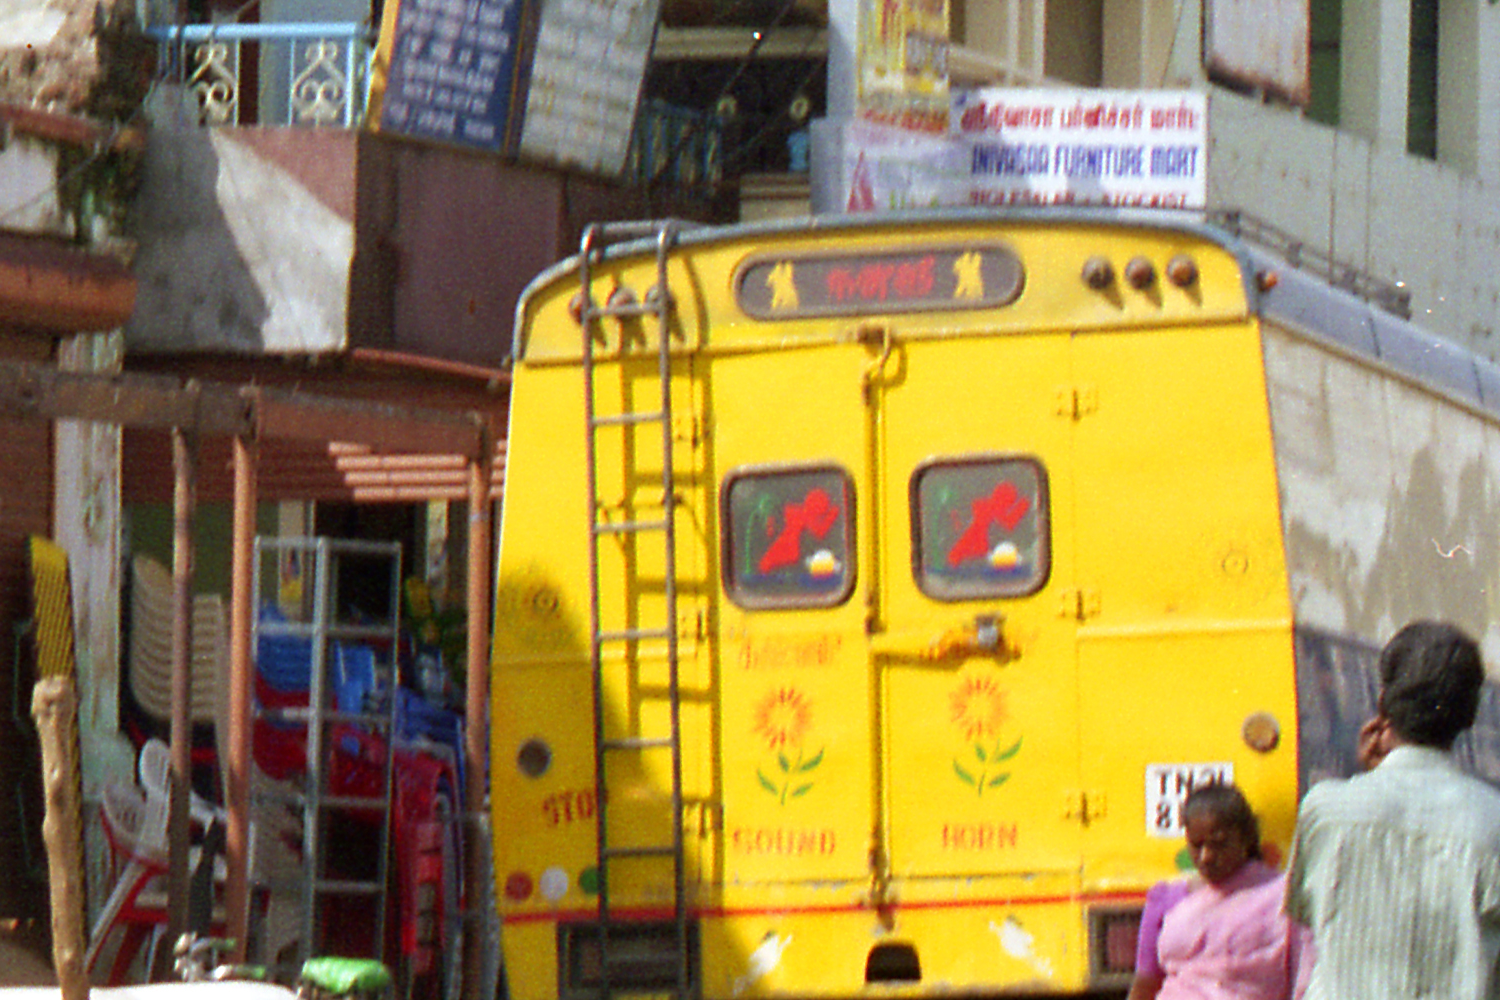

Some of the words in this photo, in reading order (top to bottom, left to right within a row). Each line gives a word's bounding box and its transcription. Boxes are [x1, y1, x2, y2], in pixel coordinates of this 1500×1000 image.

[1054, 144, 1145, 177] FURNITURE
[1150, 144, 1200, 177] MART
[731, 826, 836, 856] SOUND
[941, 822, 1019, 851] HORN
